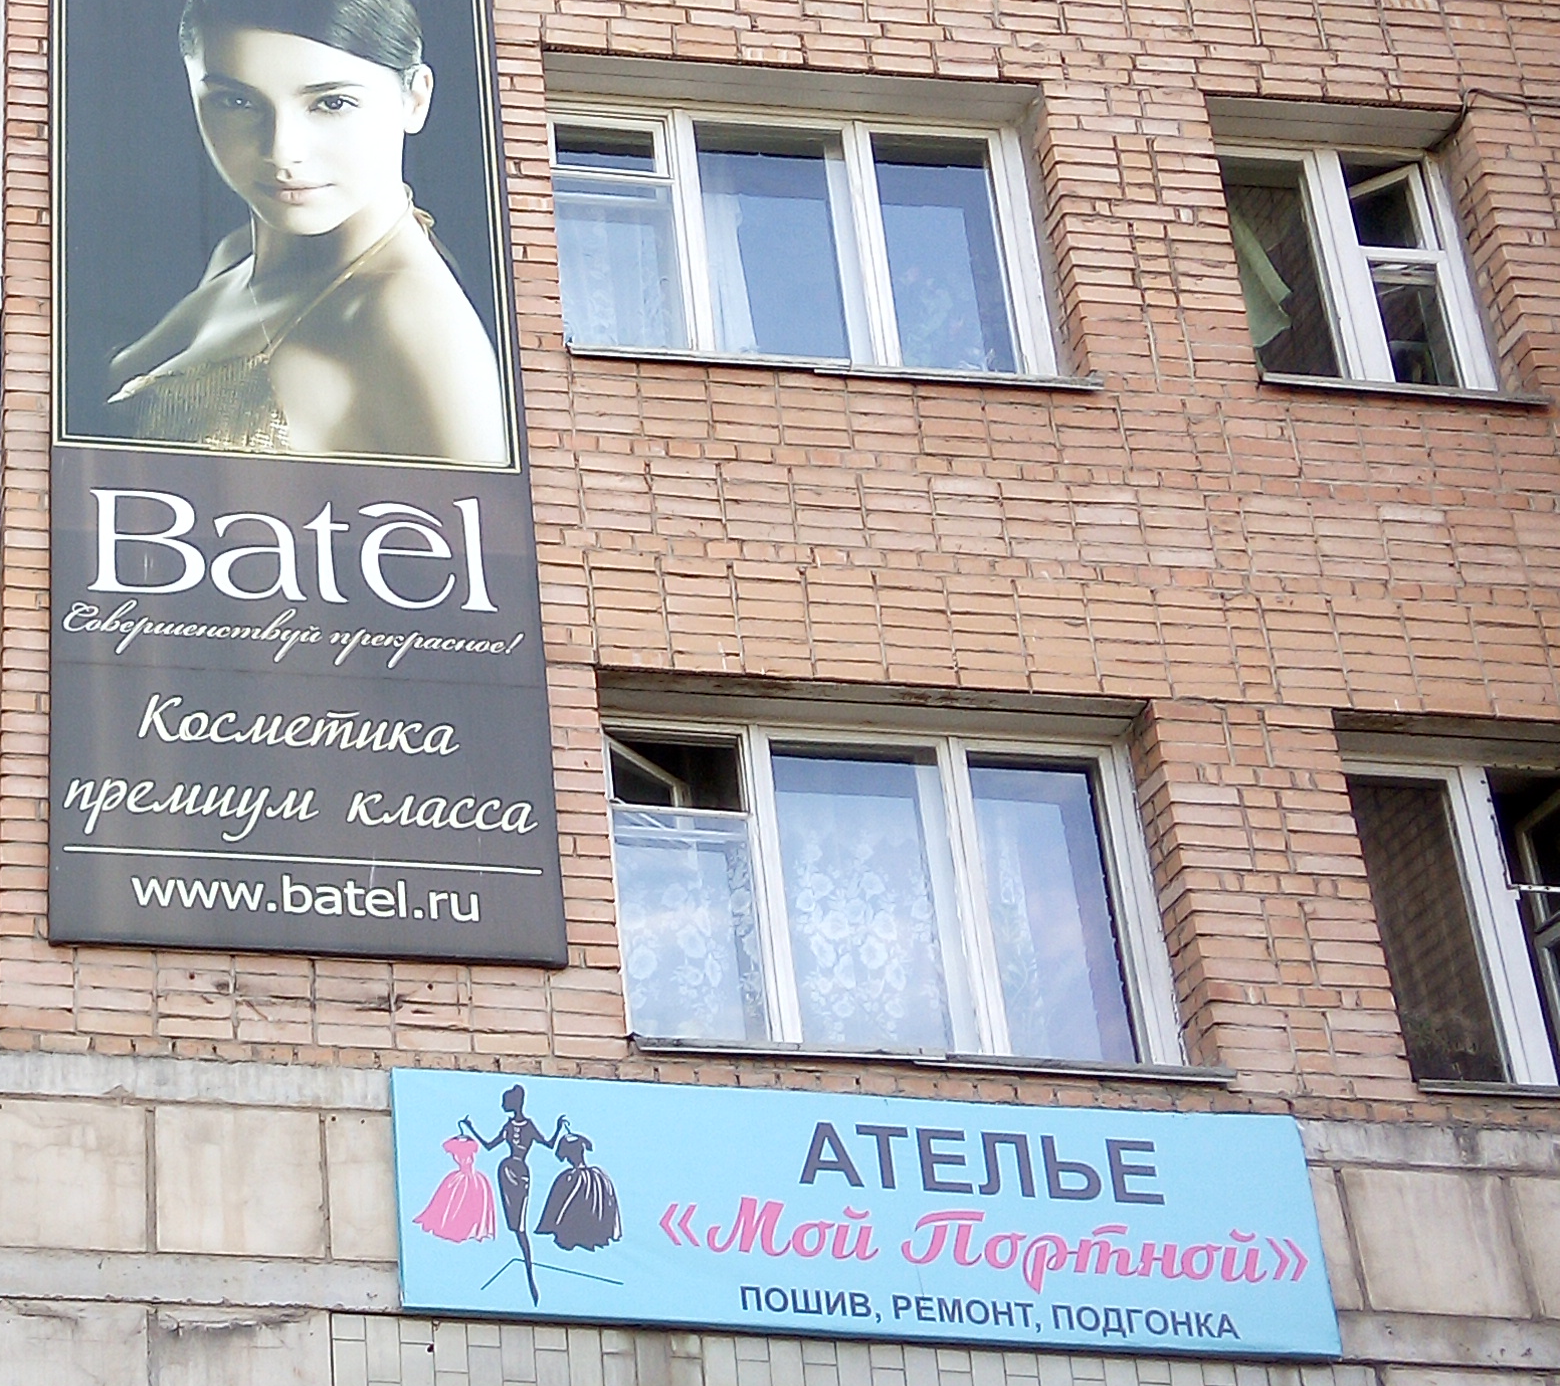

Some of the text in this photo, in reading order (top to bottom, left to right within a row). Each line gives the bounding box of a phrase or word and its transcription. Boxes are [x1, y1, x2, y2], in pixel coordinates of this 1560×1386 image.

[62, 599, 525, 669] Совершенствуй прекрасное!
[138, 693, 459, 756] Косметика
[63, 776, 539, 843] премиум класса
[131, 875, 481, 922] www.batel.ru
[799, 1122, 1165, 1205] АТЕЛЬЕ
[658, 1198, 1311, 1294] «Мой Портной»
[739, 1286, 1241, 1340] ПОШИВ, РЕМОНТ, ПОДГОНКА
